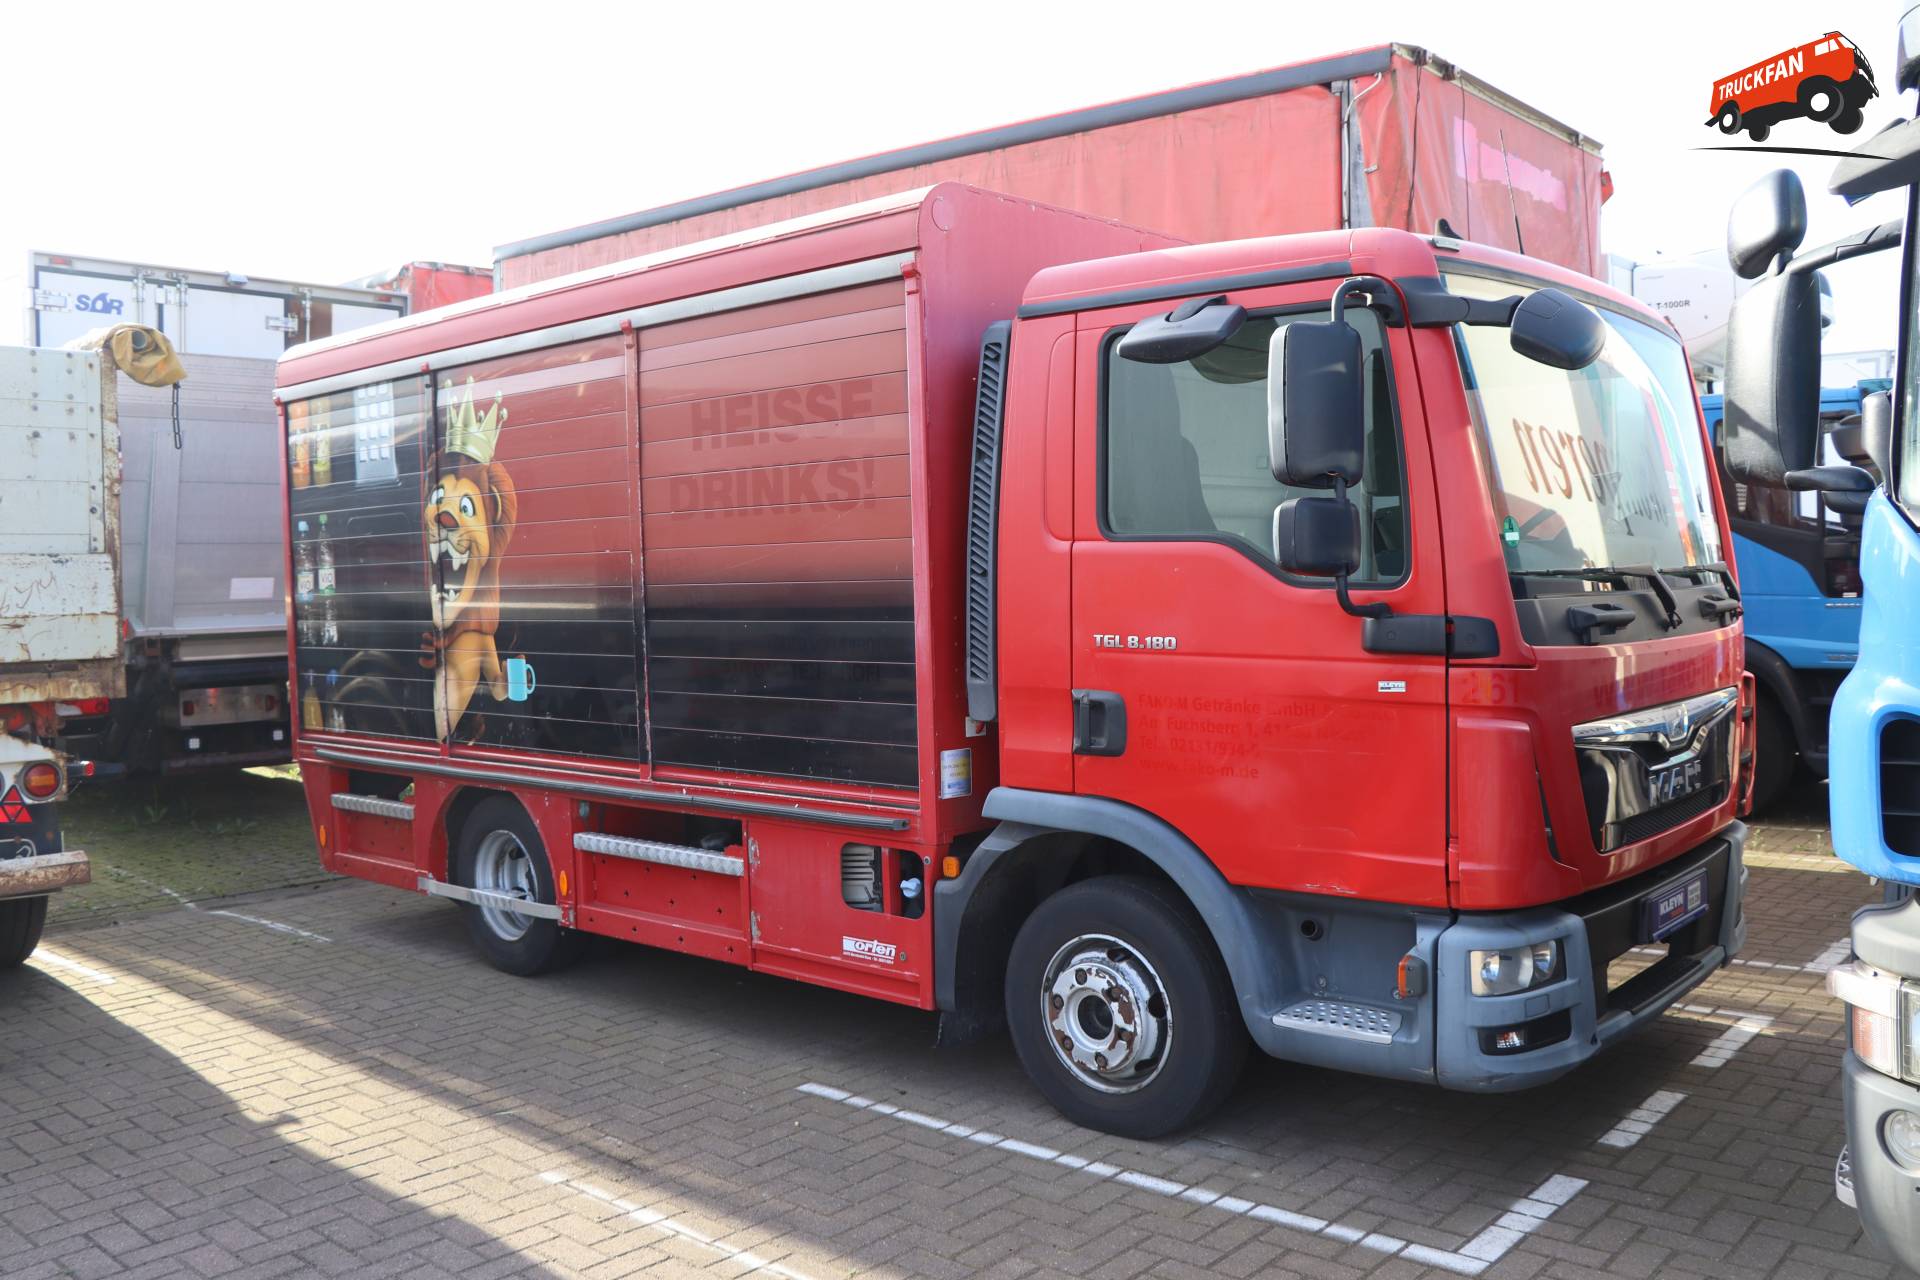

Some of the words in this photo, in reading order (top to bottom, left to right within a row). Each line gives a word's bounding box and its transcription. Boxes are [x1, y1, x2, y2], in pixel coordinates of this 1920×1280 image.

[691, 379, 873, 452] HEISSE
[669, 454, 876, 521] DRINKS!
[1093, 634, 1124, 648] TGL
[1127, 635, 1176, 650] 8.180
[1192, 696, 1261, 714] Getränke
[1268, 701, 1315, 718] mbH
[855, 940, 896, 957] orten
